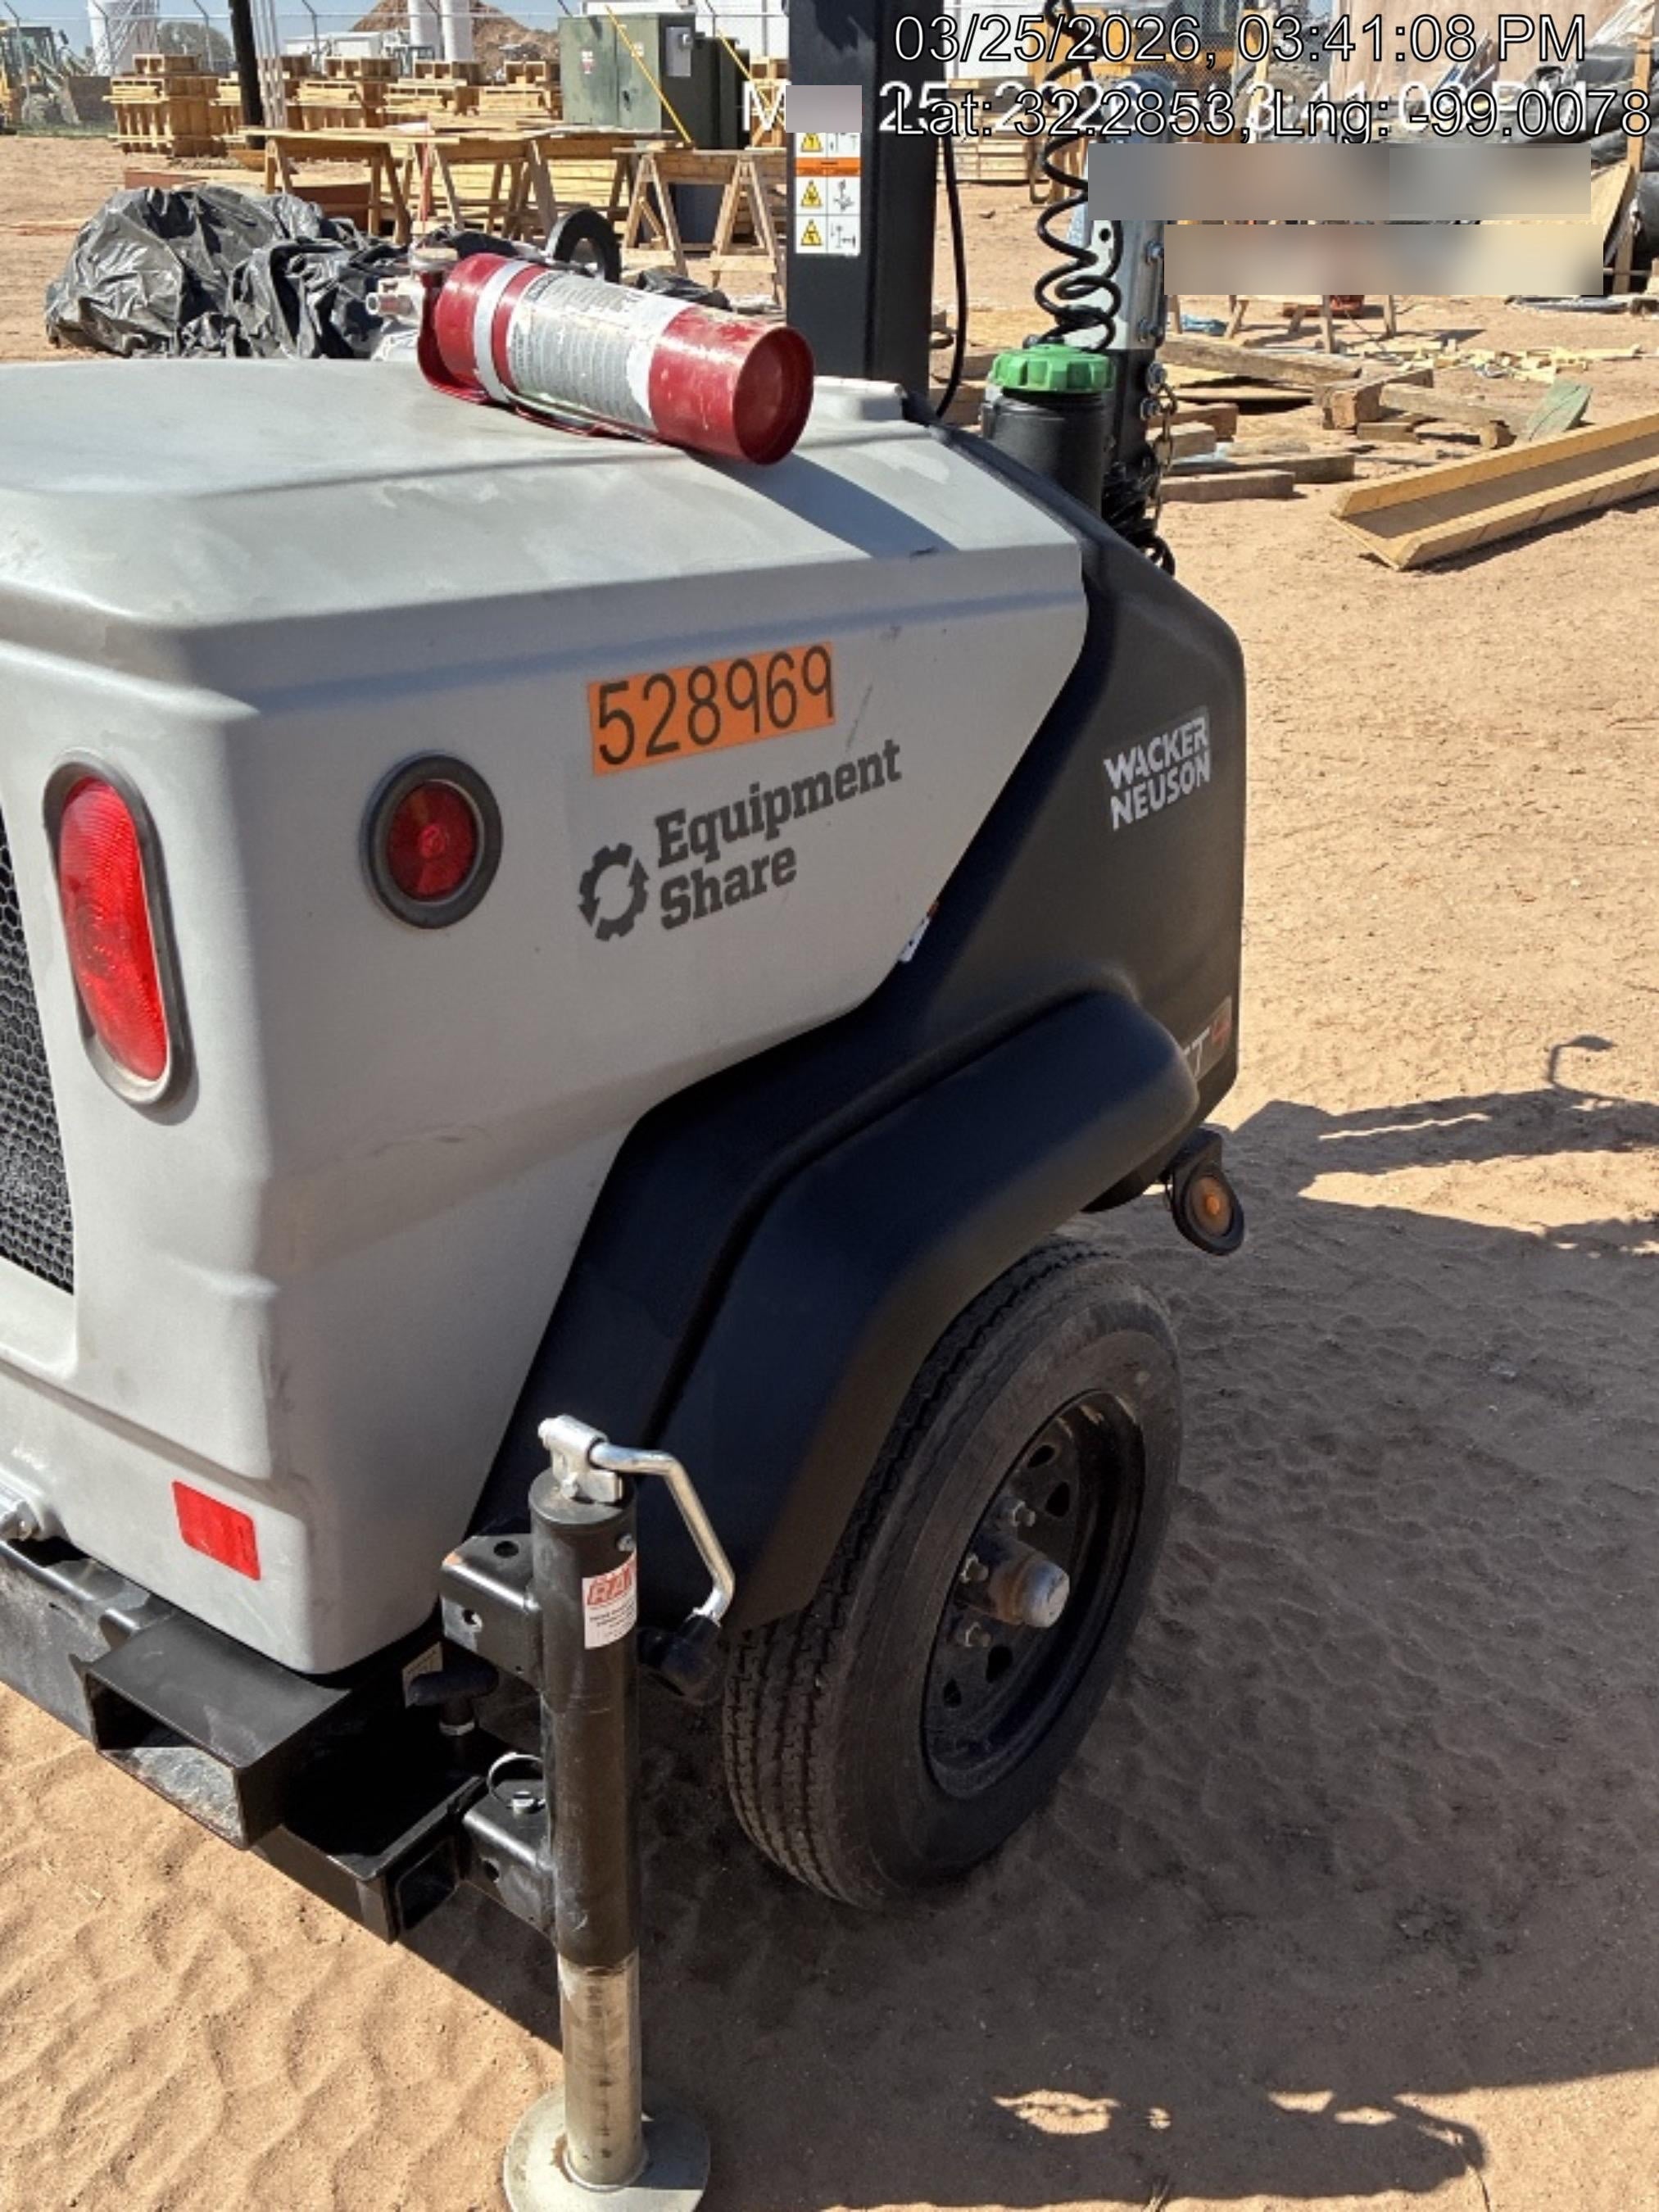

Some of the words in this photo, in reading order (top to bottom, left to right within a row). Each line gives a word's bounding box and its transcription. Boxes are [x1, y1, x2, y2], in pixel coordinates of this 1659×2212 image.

[598, 645, 834, 765] 528969
[1104, 717, 1208, 790] WACKER
[1110, 750, 1210, 831] NEUSON
[655, 739, 902, 868] Equipment
[660, 845, 798, 931] Share
